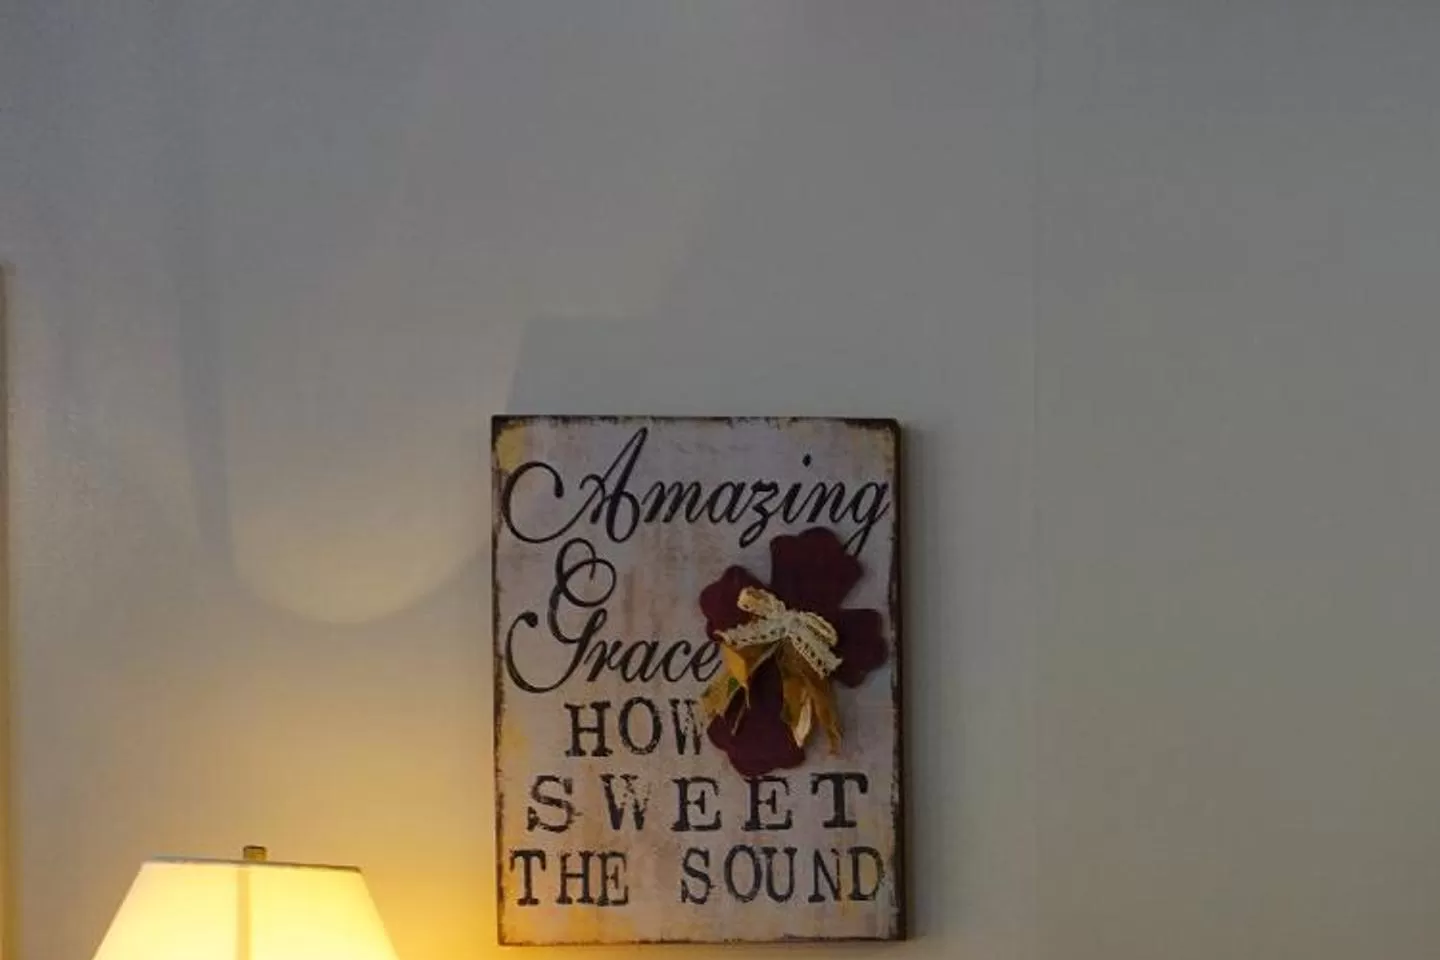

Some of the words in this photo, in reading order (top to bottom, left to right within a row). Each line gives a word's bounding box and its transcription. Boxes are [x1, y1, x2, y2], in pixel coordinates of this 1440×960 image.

[500, 427, 890, 555] Amazing
[505, 538, 722, 693] Grace
[527, 772, 868, 832] SWEET
[509, 850, 629, 906] THE
[681, 845, 884, 904] SOUND
